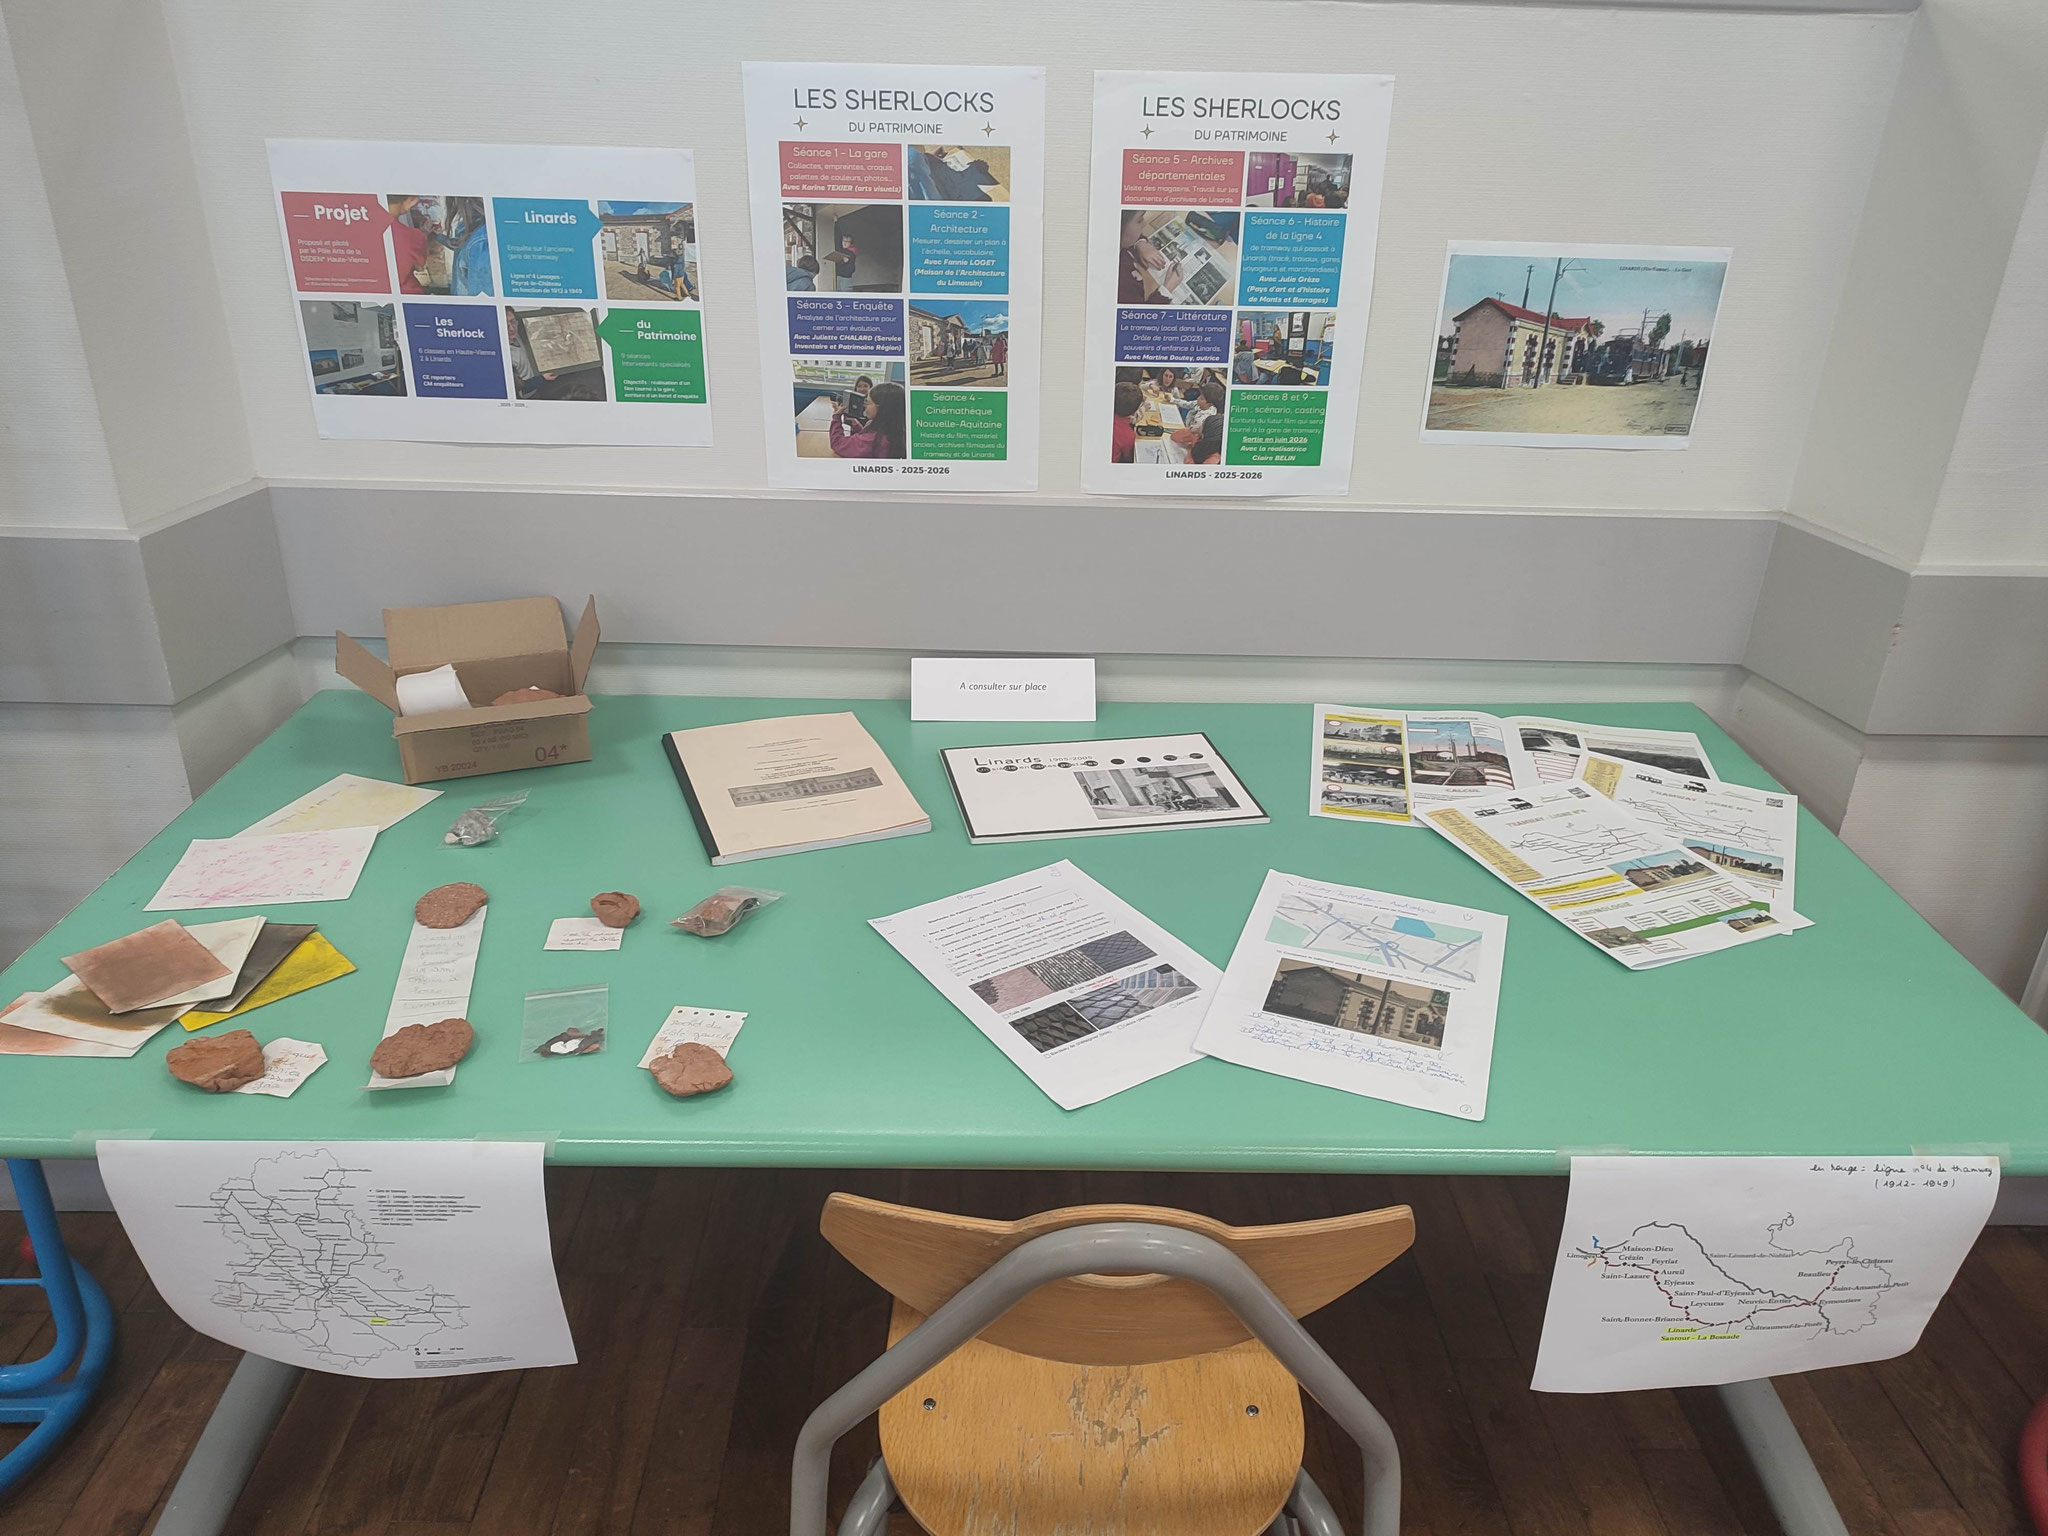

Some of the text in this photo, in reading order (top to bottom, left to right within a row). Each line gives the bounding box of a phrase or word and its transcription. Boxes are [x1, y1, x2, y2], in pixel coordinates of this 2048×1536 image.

[794, 88, 994, 113] LES SHERLOCKS
[1143, 96, 1341, 120] LES SHERLOCKS
[848, 122, 943, 134] DU PATRIMOINE
[1194, 130, 1288, 142] DU PATRIMOINE
[793, 146, 831, 157] Séance
[849, 149, 861, 158] La
[864, 151, 888, 160] gare
[1132, 154, 1234, 165] Séance 5 Archives
[1139, 170, 1226, 181] départementales
[314, 204, 369, 225] Projet
[525, 210, 576, 224] Linards
[934, 209, 977, 219] Séance 2
[1251, 216, 1286, 225] Séance
[1305, 217, 1339, 226] Histoire
[930, 224, 988, 233] Architecture
[1266, 232, 1277, 240] de
[1280, 232, 1288, 240] la
[1291, 232, 1314, 242] ligne
[796, 300, 893, 312] Séance 3 Enquête
[1122, 310, 1227, 320] Séance 7 Littérature
[434, 316, 453, 326] Les
[637, 320, 651, 328] du
[437, 328, 485, 338] Sherlock
[638, 331, 696, 340] Patrimoine
[933, 392, 966, 401] Séance
[1240, 392, 1279, 401] Séances
[1282, 393, 1288, 401] 8
[926, 406, 992, 416] Cinémathèque
[1295, 407, 1325, 415] casting
[916, 419, 1002, 429] Nouvelle-Aquitaine
[969, 682, 1006, 690] consulter
[1025, 683, 1047, 692] place
[974, 756, 1042, 766] Linards
[1649, 789, 1697, 801] TRAMWAY
[1809, 1164, 1824, 1172] en
[1831, 1163, 1858, 1177] rouge
[1873, 1163, 1906, 1177] ligne
[1937, 1163, 1947, 1172] de
